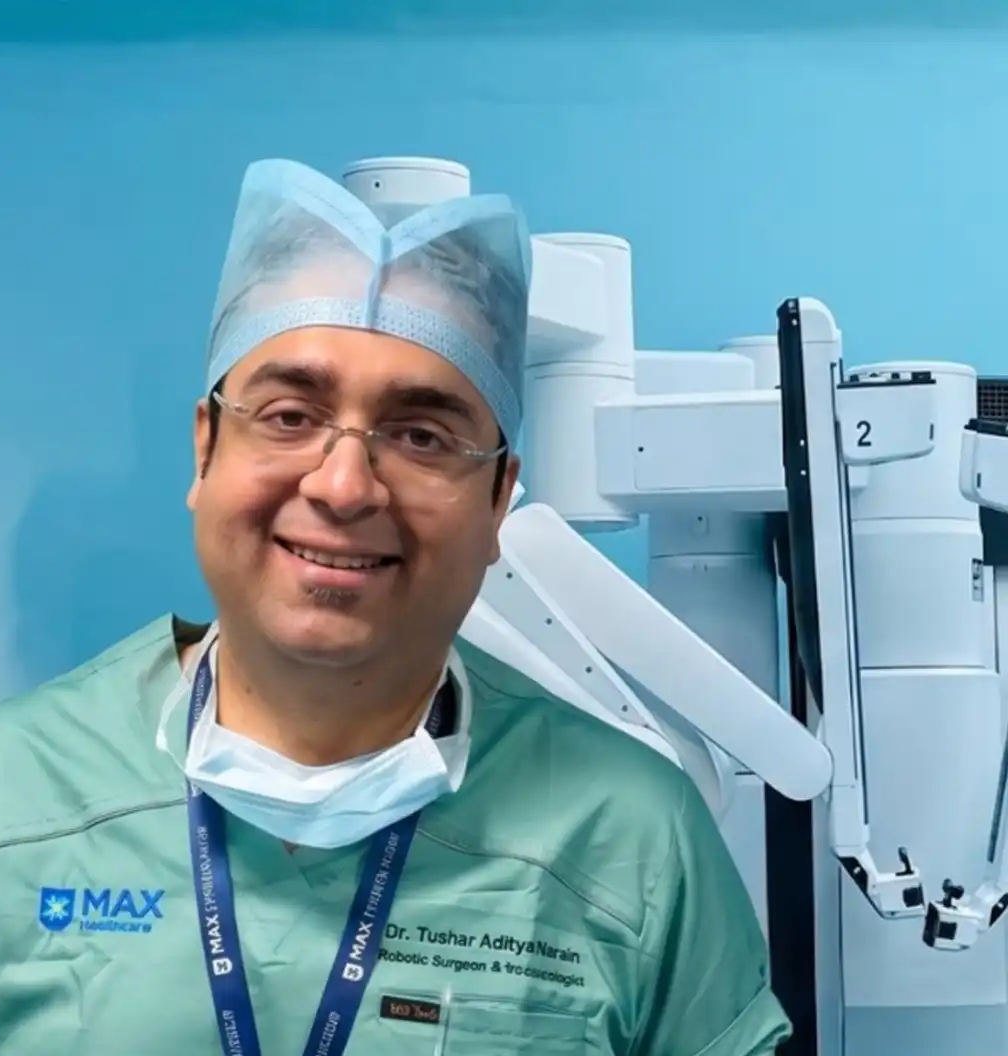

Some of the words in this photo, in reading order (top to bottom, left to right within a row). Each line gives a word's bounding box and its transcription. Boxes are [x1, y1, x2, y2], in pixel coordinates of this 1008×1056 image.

[856, 420, 872, 447] 2
[82, 888, 166, 919] MAX
[205, 914, 225, 955] MAX
[349, 922, 374, 961] MAX
[384, 923, 410, 941] Dr.
[416, 926, 476, 948] Tushar
[479, 933, 534, 957] Aditya
[378, 948, 429, 966] Robotic
[432, 955, 487, 973] Surgeon
[491, 961, 502, 973] &
